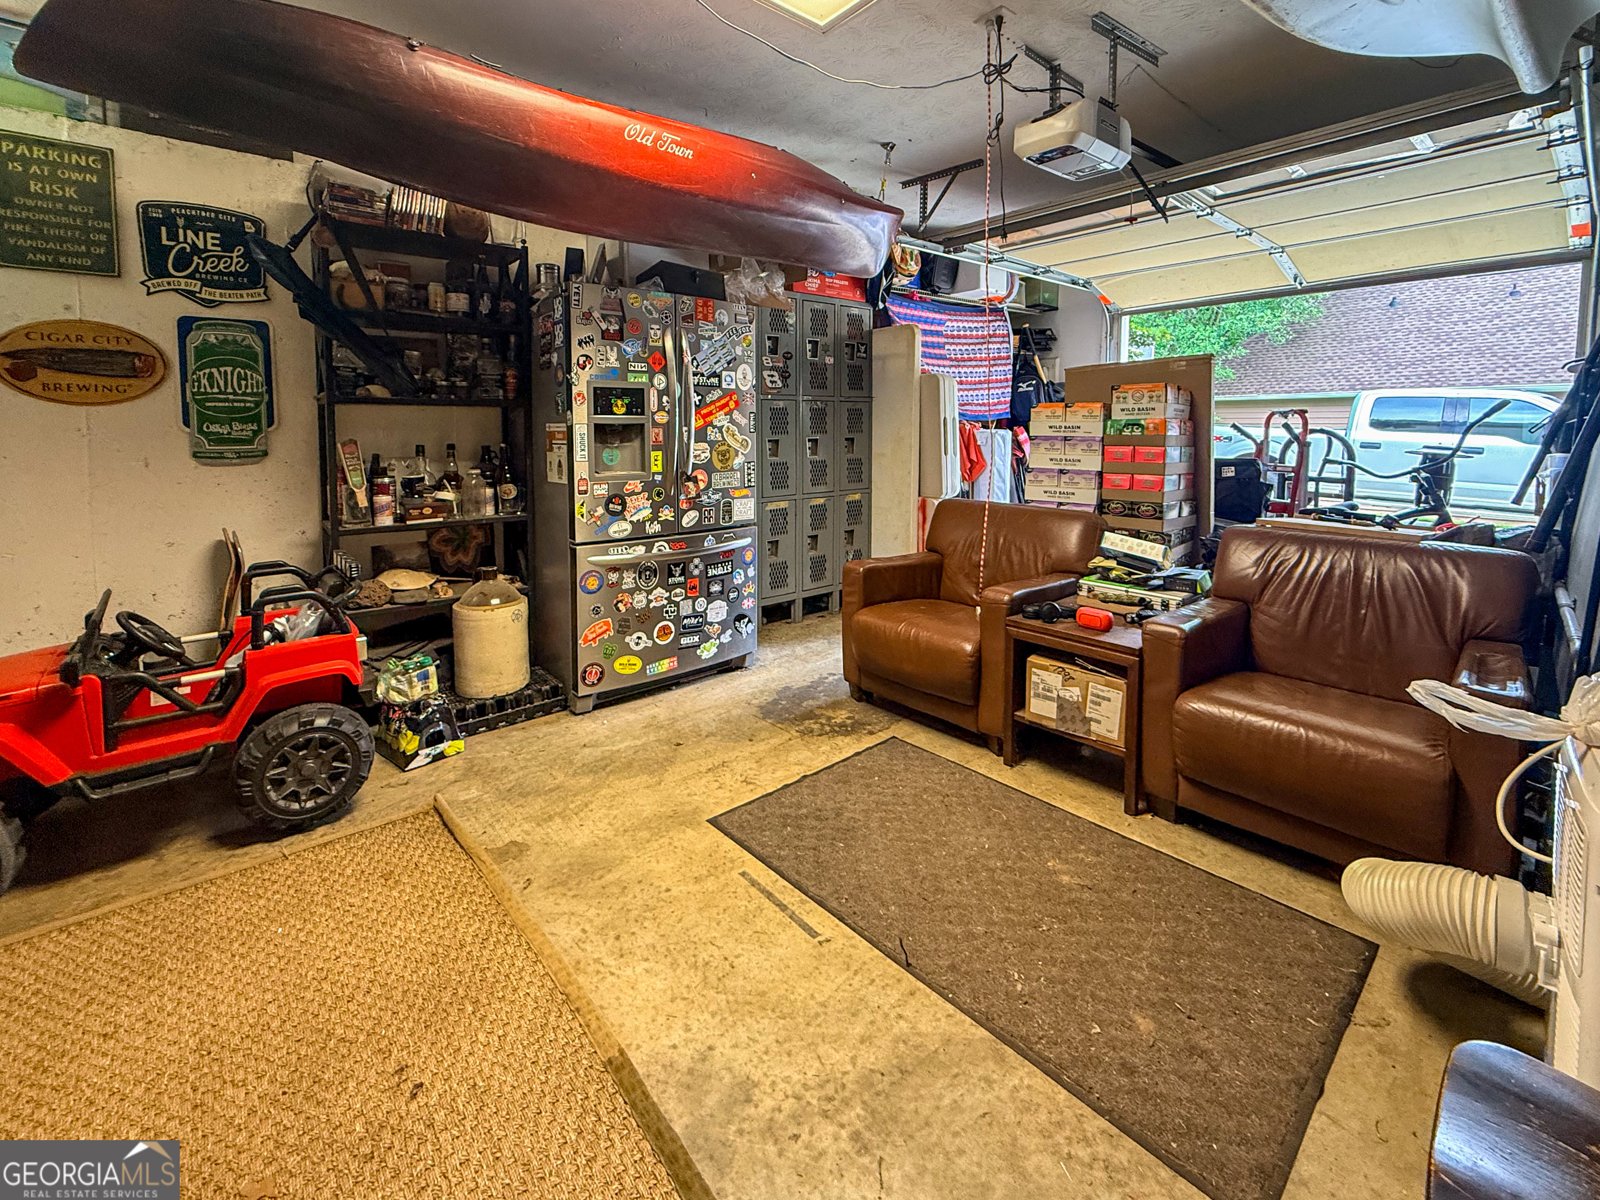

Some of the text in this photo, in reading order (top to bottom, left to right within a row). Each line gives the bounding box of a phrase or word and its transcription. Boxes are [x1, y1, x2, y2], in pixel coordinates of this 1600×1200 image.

[624, 123, 694, 159] Old Town
[1, 140, 102, 169] PARKING
[8, 161, 97, 183] IS AT OWN
[29, 180, 79, 199] RISK
[14, 197, 95, 214] OWNER NOT
[0, 208, 112, 229] RESPONSIBLE FOR
[8, 237, 106, 255] VANDALISM OF
[90, 233, 107, 242] OR
[161, 226, 221, 251] LINE
[26, 253, 92, 266] ANY KIND
[167, 242, 249, 277] Creek
[151, 280, 198, 289] BREWED OFF
[195, 273, 234, 282] BREWING
[204, 287, 262, 299] THE BEATEN PATH
[573, 285, 581, 307] YETI
[25, 331, 133, 346] CIGAR CITY
[1212, 435, 1233, 443] X4
[707, 564, 732, 577] STONE
